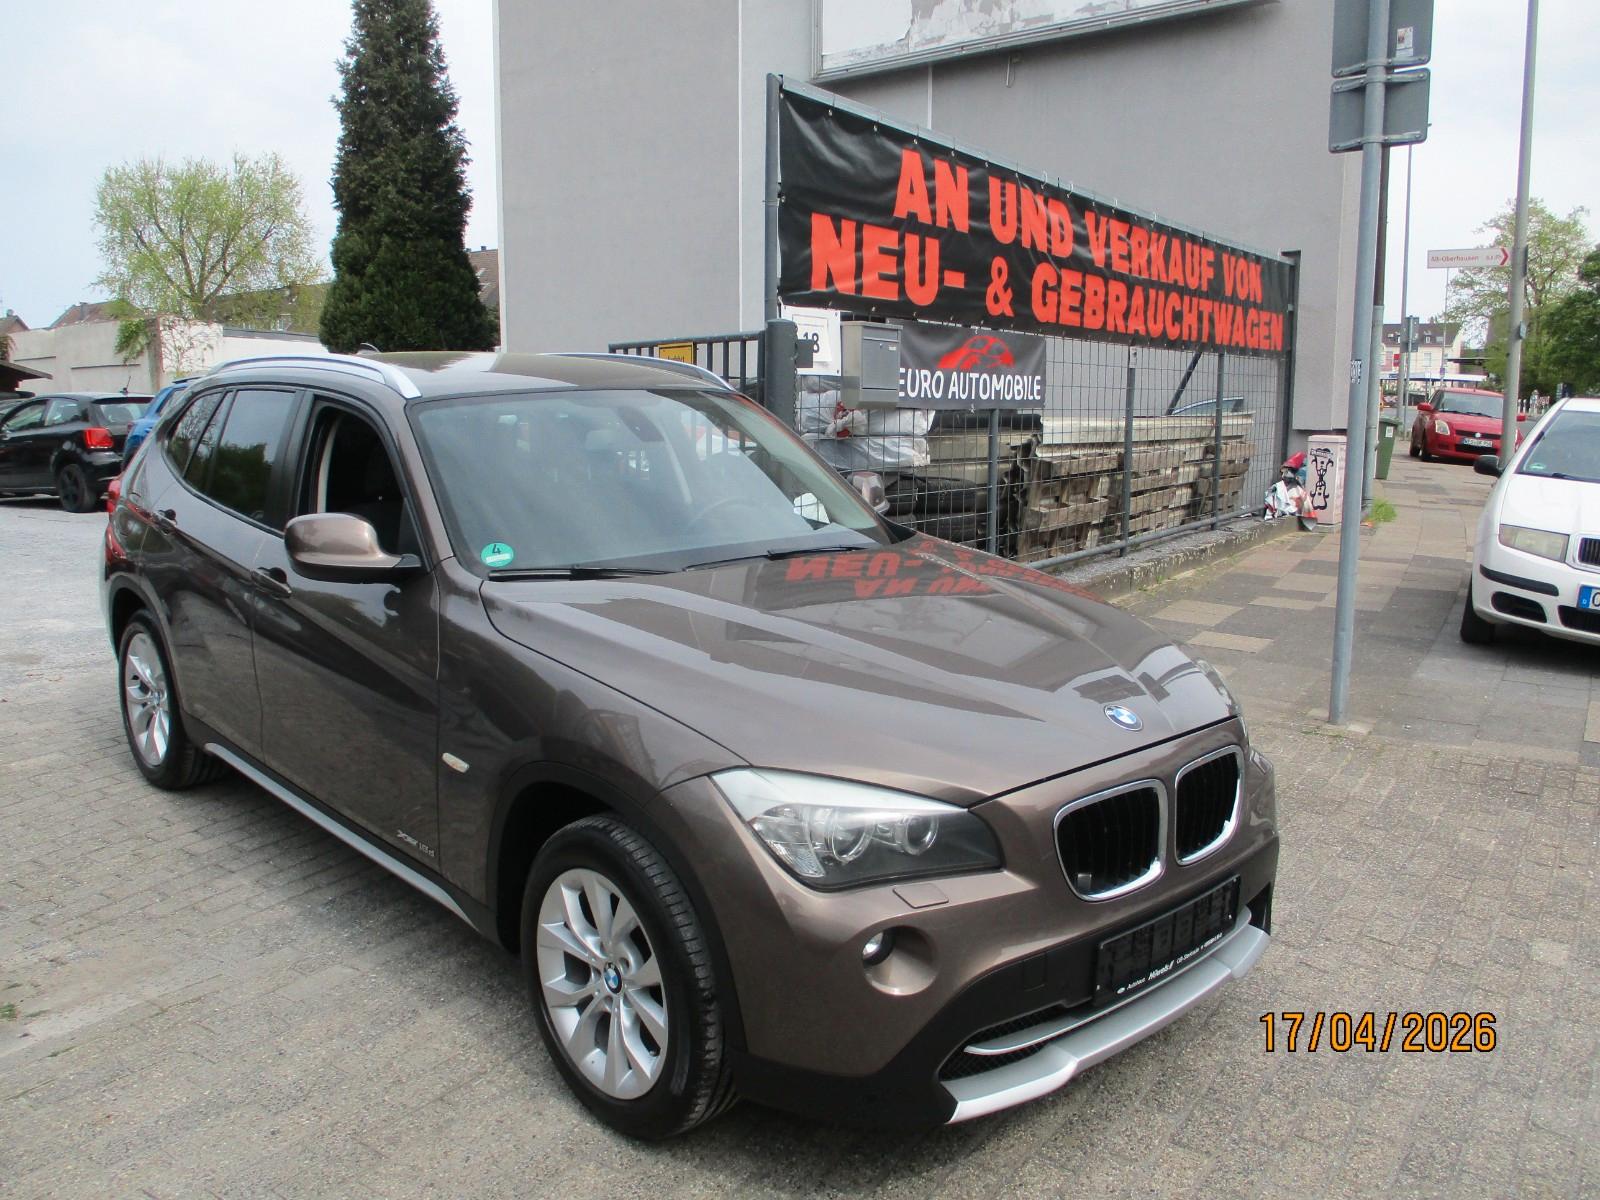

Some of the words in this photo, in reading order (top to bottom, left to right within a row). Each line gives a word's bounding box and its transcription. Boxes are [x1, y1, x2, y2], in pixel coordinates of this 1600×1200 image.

[892, 149, 969, 233] AN
[988, 175, 1074, 257] UND
[1085, 210, 1215, 291] VERKAUF
[1223, 252, 1263, 304] VON
[810, 212, 966, 306] NEU-
[985, 256, 1014, 317] &
[1031, 262, 1284, 351] GEBRAUCHTWAGEN
[898, 367, 944, 399] EURO
[948, 371, 1041, 400] AUTOMOBILE
[492, 543, 502, 554] 4
